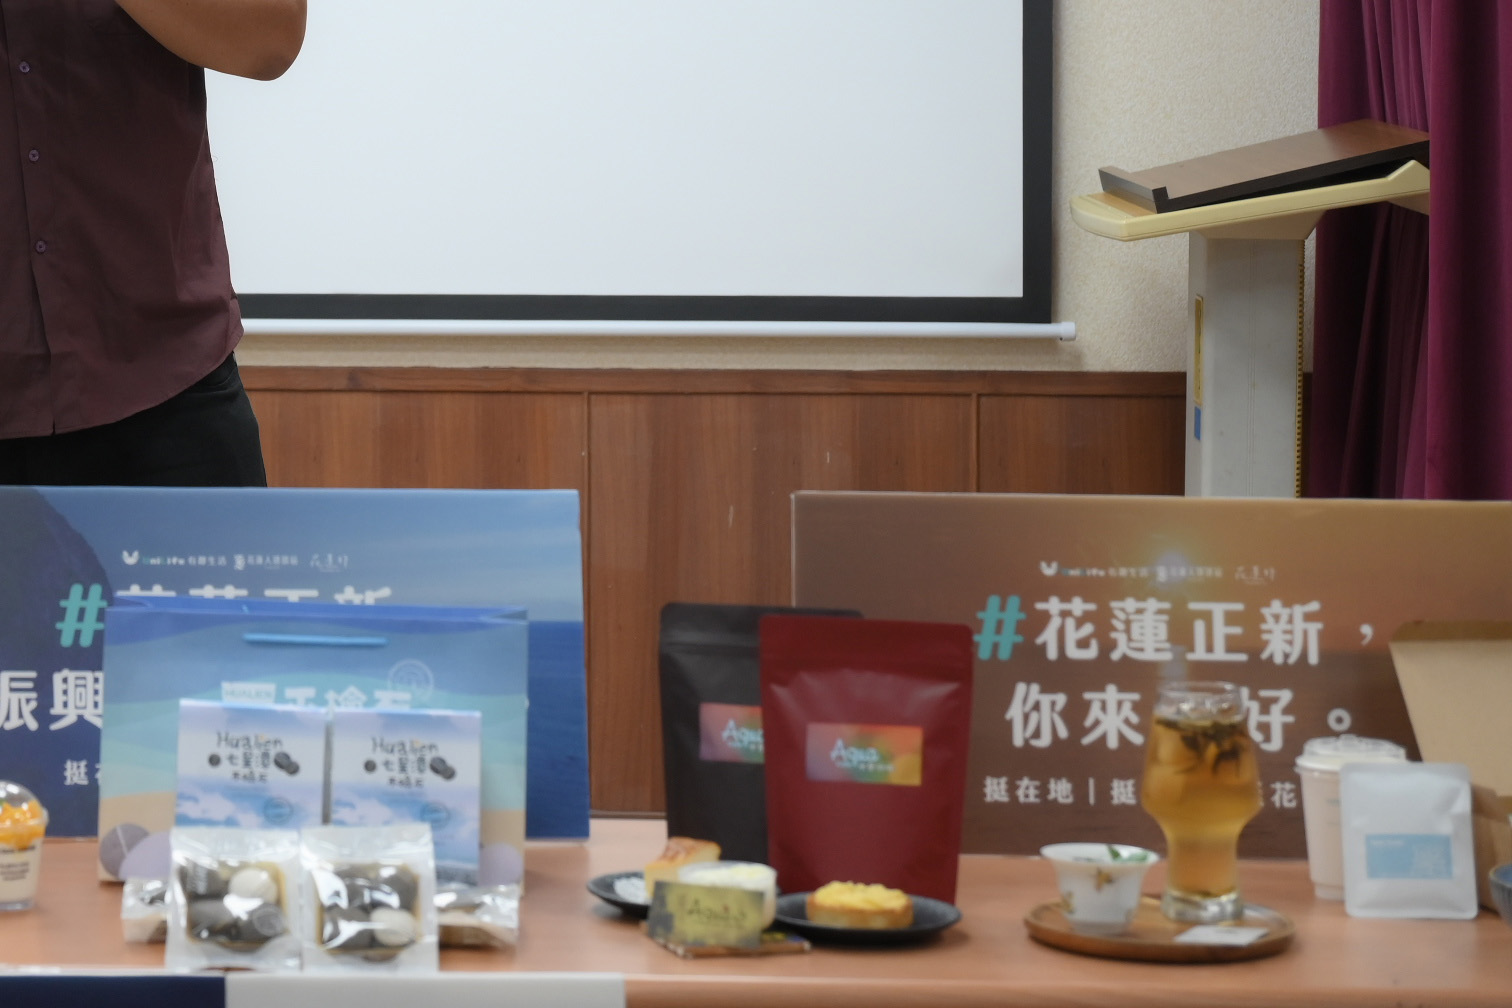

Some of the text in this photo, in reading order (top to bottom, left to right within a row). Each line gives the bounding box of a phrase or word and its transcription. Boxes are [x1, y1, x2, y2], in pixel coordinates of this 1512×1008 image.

[973, 594, 1375, 666] #花蓮正新，
[64, 759, 104, 786] 挺
